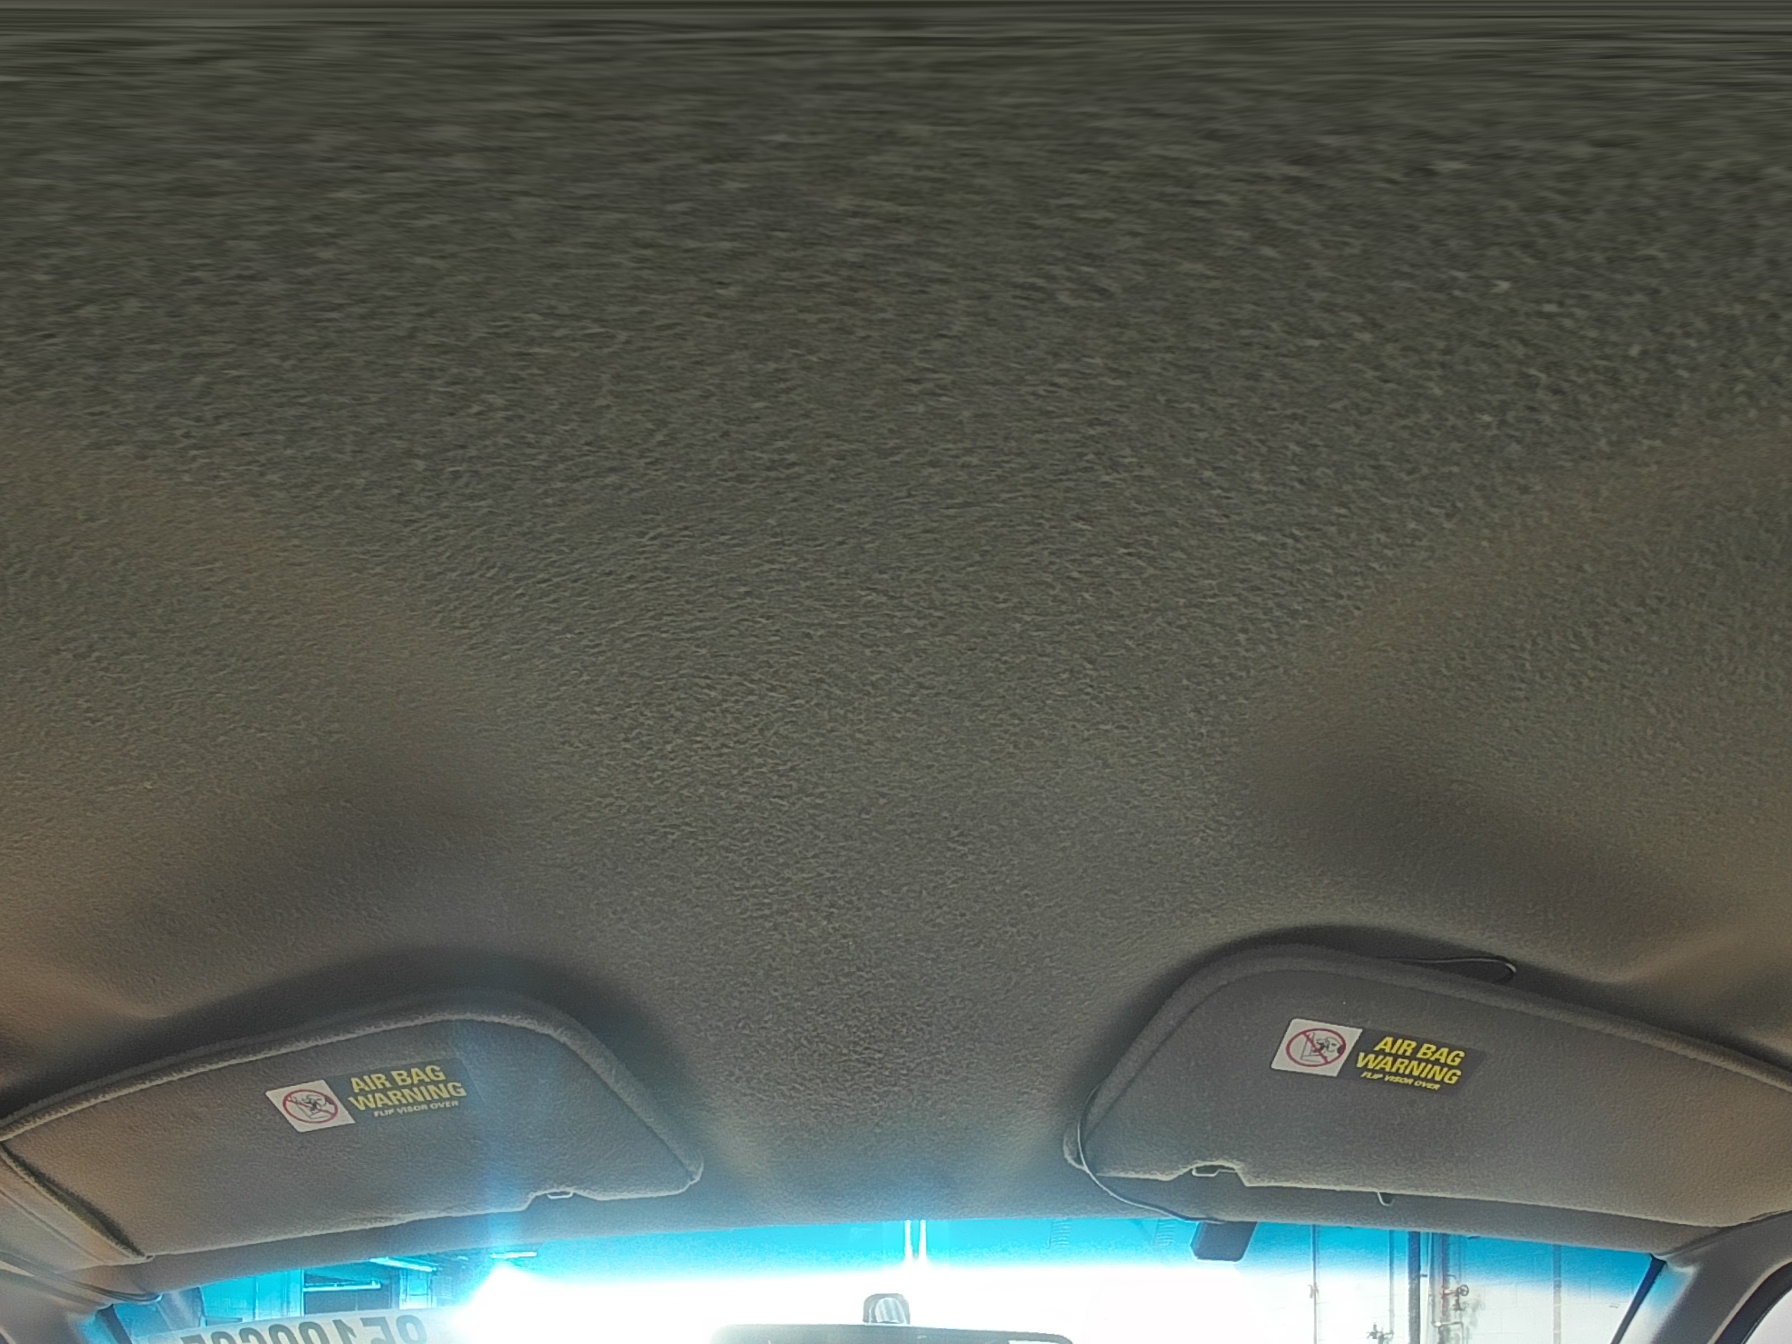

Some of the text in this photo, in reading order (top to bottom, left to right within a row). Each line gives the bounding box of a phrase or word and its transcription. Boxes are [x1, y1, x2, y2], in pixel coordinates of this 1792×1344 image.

[1374, 1036, 1465, 1066] AIR BAG
[350, 1065, 446, 1093] AIR BAG
[1356, 1052, 1462, 1085] WARNING
[348, 1082, 467, 1111] WARNING
[430, 1100, 460, 1110] OVER
